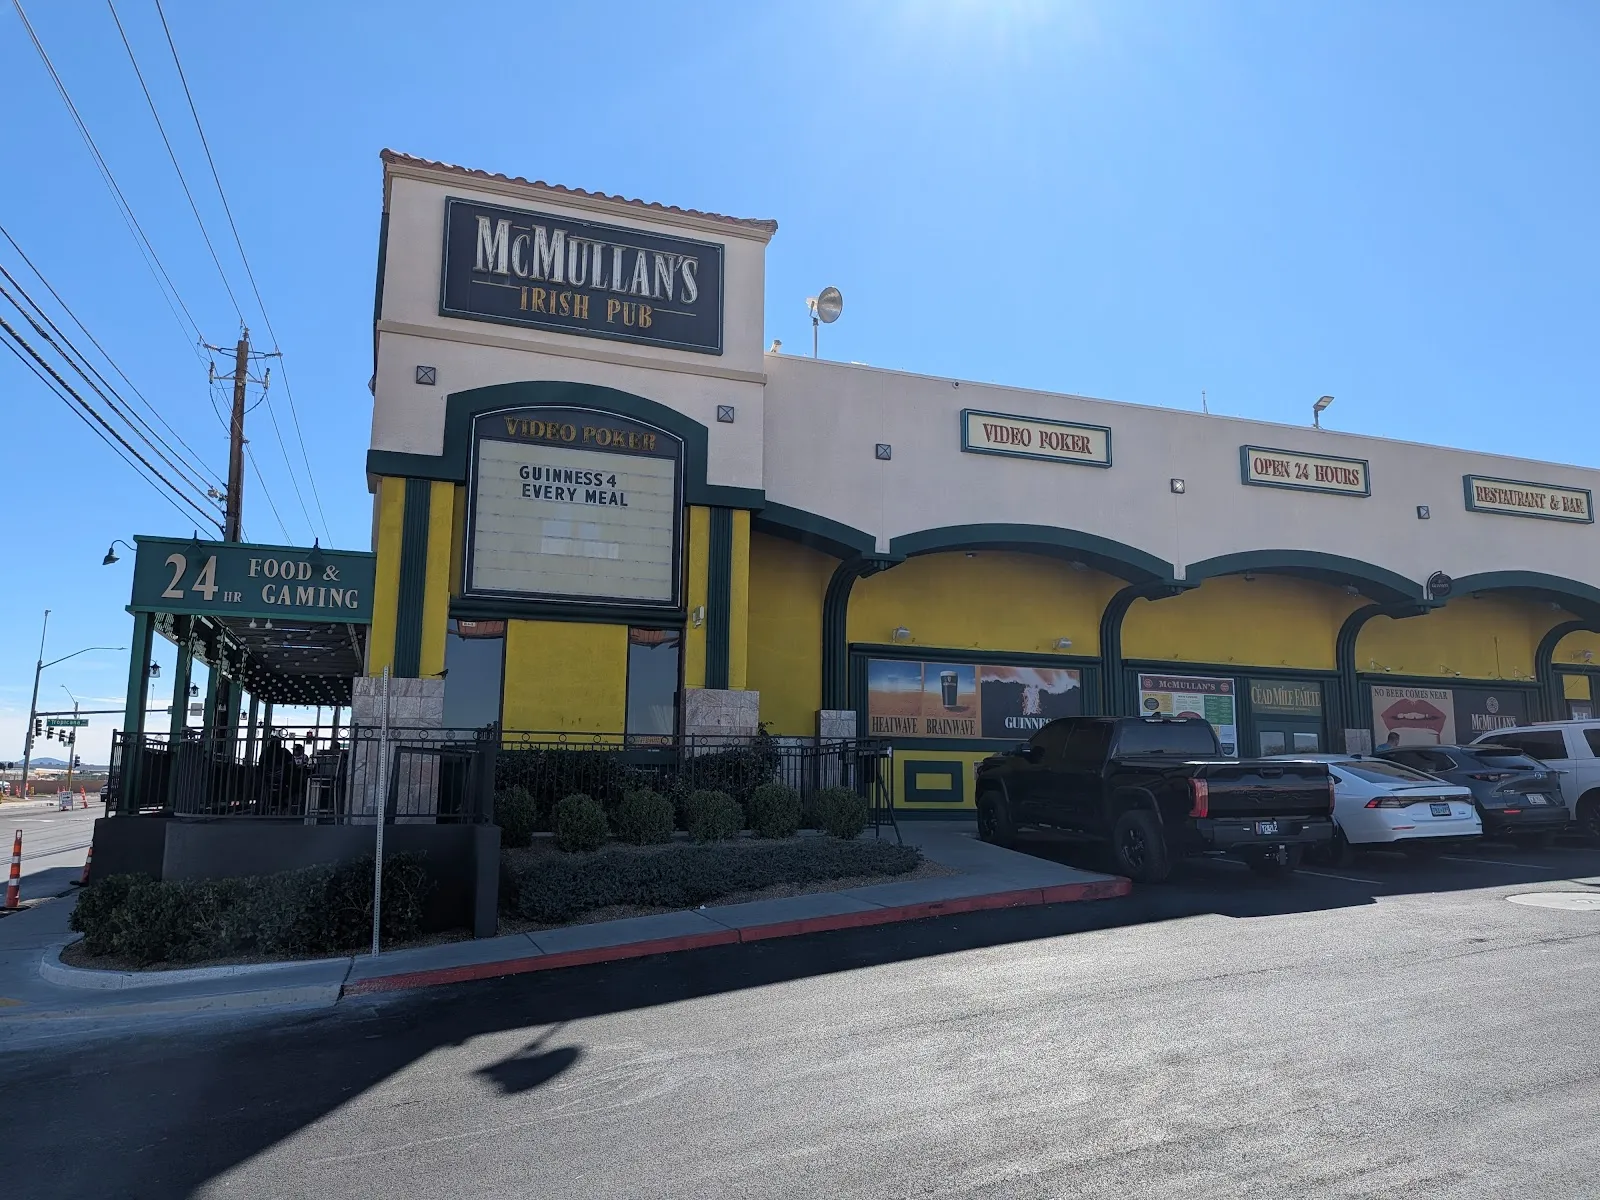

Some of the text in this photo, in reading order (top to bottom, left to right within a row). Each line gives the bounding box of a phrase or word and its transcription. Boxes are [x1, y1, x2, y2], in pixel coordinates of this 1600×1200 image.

[519, 286, 653, 329] IRISH PUB
[503, 416, 657, 451] VIDEO POKER
[982, 423, 1093, 454] VIDEO POKER
[519, 465, 617, 488] GUINNESS 4
[1253, 457, 1360, 485] OPEN 24 HOURS
[522, 483, 628, 507] EVERY MEAL
[1475, 485, 1585, 513] RESTAURANT & BAR
[161, 553, 242, 603] 24 HR
[248, 558, 341, 581] FOOD &
[261, 584, 359, 609] GAMING
[1374, 688, 1448, 700] NO BEER COMES NEAR
[872, 716, 918, 734] HEATWAVE
[926, 718, 976, 736] BRAINWAVE
